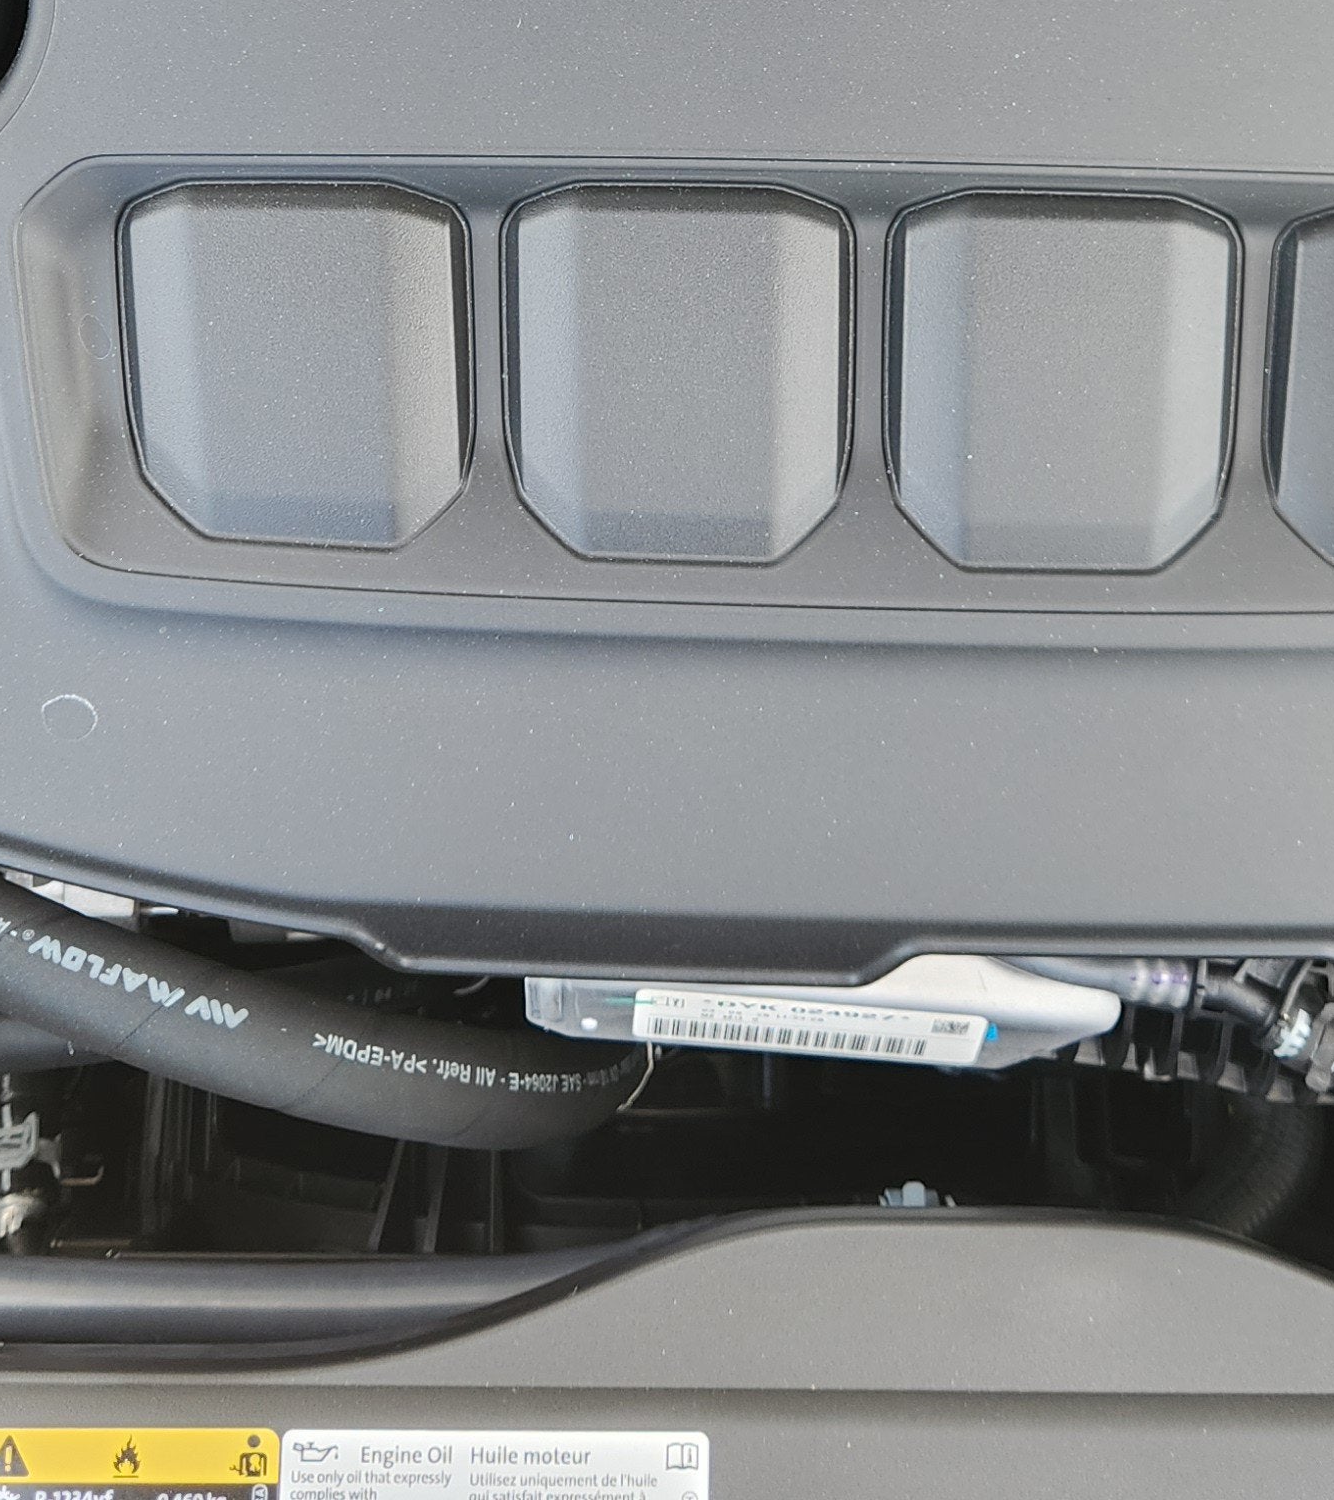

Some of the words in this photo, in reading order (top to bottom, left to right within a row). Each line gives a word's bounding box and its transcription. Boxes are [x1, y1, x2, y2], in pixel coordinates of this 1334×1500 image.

[312, 1031, 428, 1074] >PA-EPDM<
[431, 1057, 472, 1080] Refr.
[476, 1066, 496, 1087] All
[361, 1445, 422, 1468] Engine
[427, 1445, 453, 1464] Oil
[471, 1446, 518, 1465] Huile
[524, 1447, 591, 1465] moteur
[291, 1471, 314, 1484] Use
[317, 1470, 344, 1487] only
[347, 1470, 362, 1484] oil
[365, 1470, 391, 1484] that
[394, 1470, 452, 1488] expressly
[469, 1473, 516, 1487] Utilisez
[520, 1473, 598, 1490] uniquement
[601, 1473, 618, 1487] de
[620, 1473, 658, 1487] l'huile
[290, 1487, 345, 1500] complies
[349, 1487, 377, 1500] with
